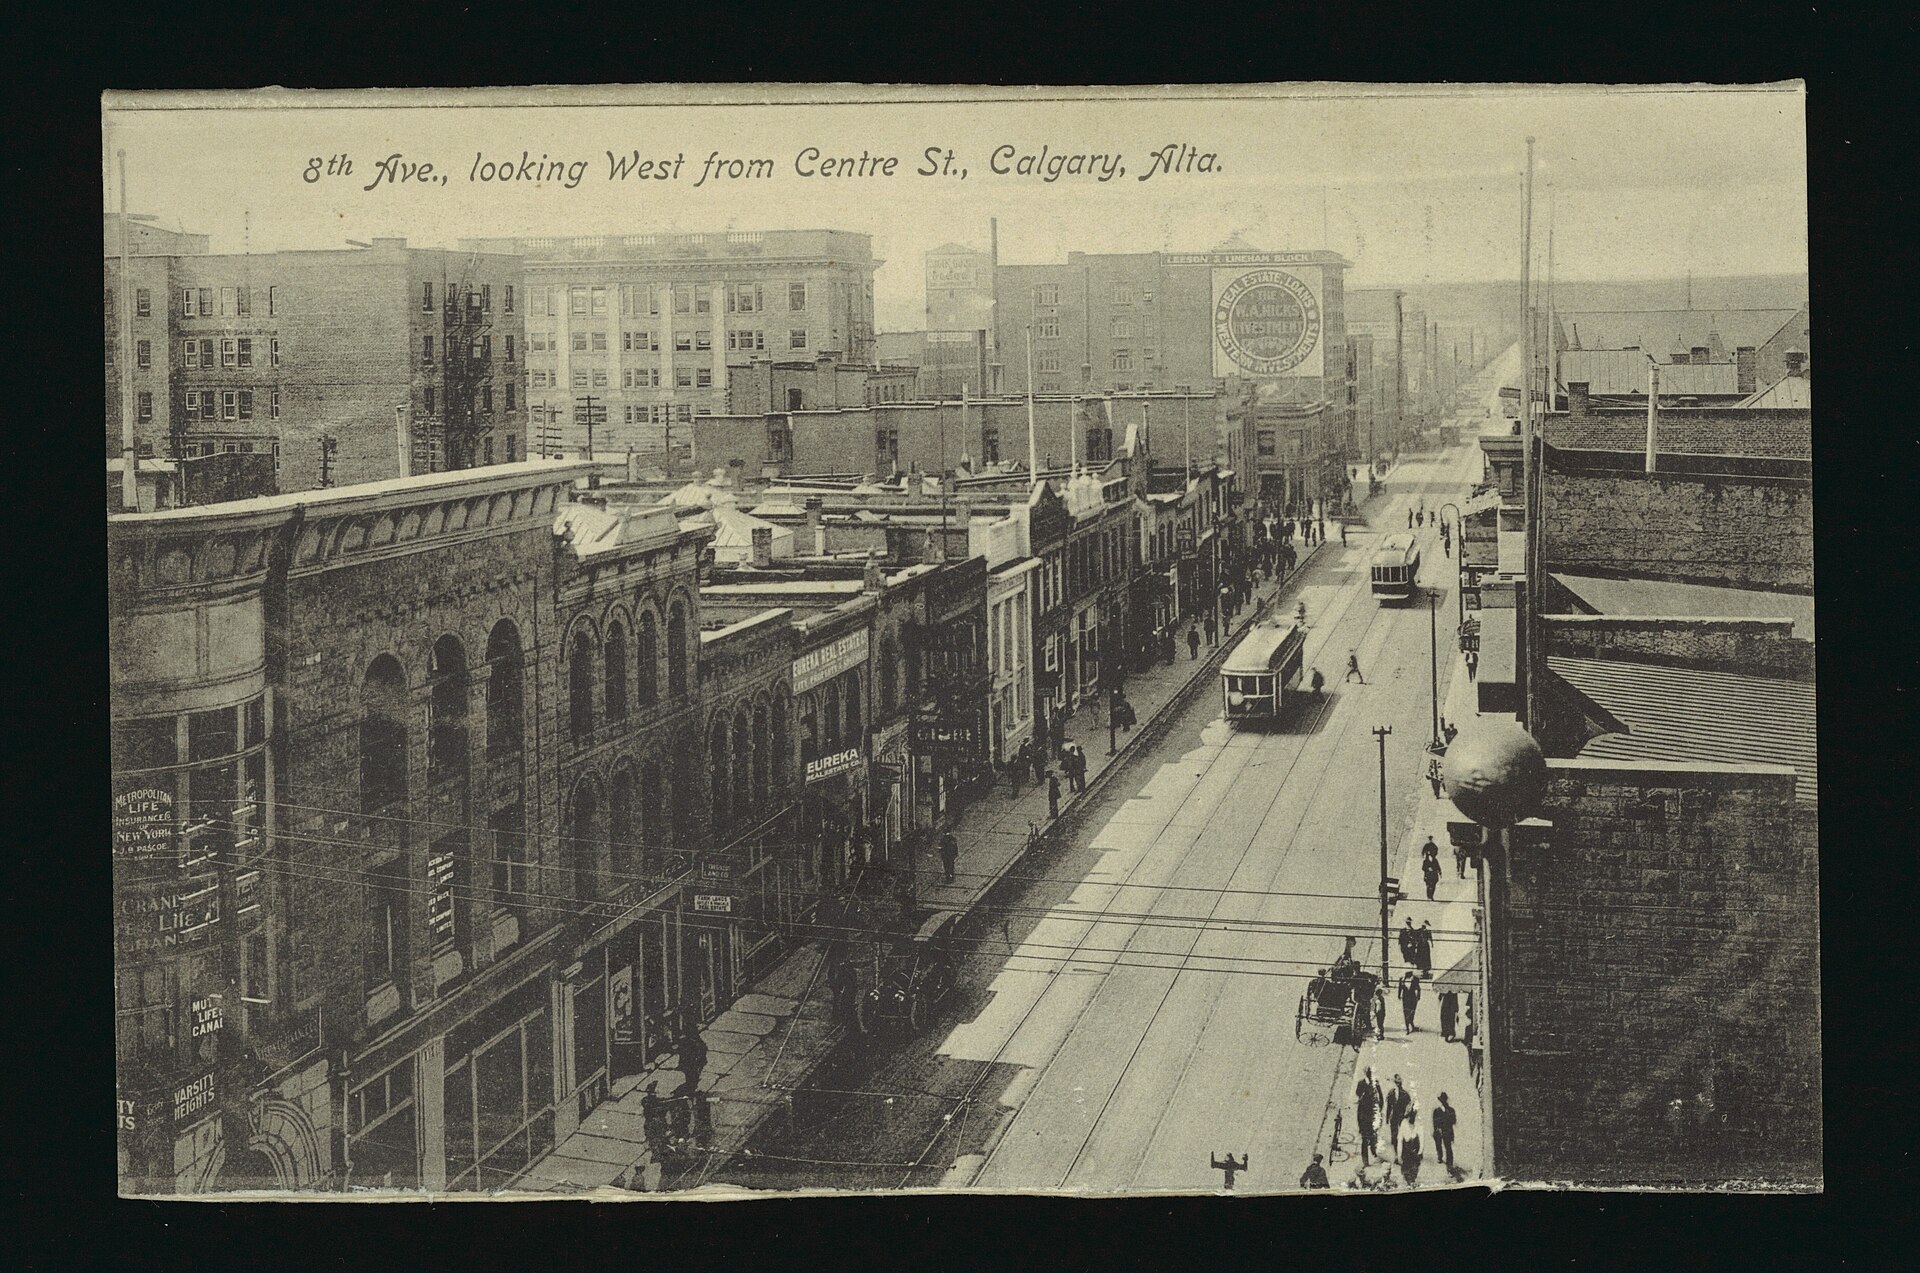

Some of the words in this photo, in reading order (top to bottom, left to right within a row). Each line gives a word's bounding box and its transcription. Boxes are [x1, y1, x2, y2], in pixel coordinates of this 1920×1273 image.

[1167, 255, 1208, 264] LEESON
[1225, 254, 1270, 263] LINEHAM
[1274, 253, 1309, 263] BLOCK
[1219, 282, 1244, 309] REAL
[1284, 276, 1315, 309] LOANS
[1216, 322, 1253, 369] WESTERN
[1254, 322, 1319, 373] INVESTMENTS
[793, 652, 820, 677] EUREKA
[821, 643, 838, 665] REAL
[805, 771, 825, 782] REAL
[824, 762, 850, 776] ESTATE
[807, 748, 859, 774] EUREKA
[115, 789, 173, 811] METROPOLITAN
[129, 802, 160, 814] LIFE
[115, 814, 164, 827] INSURANCE
[116, 830, 142, 843] NEW
[144, 828, 172, 840] YORK
[174, 1072, 215, 1105] VARSITY
[174, 1087, 215, 1121] HEIGHTS
